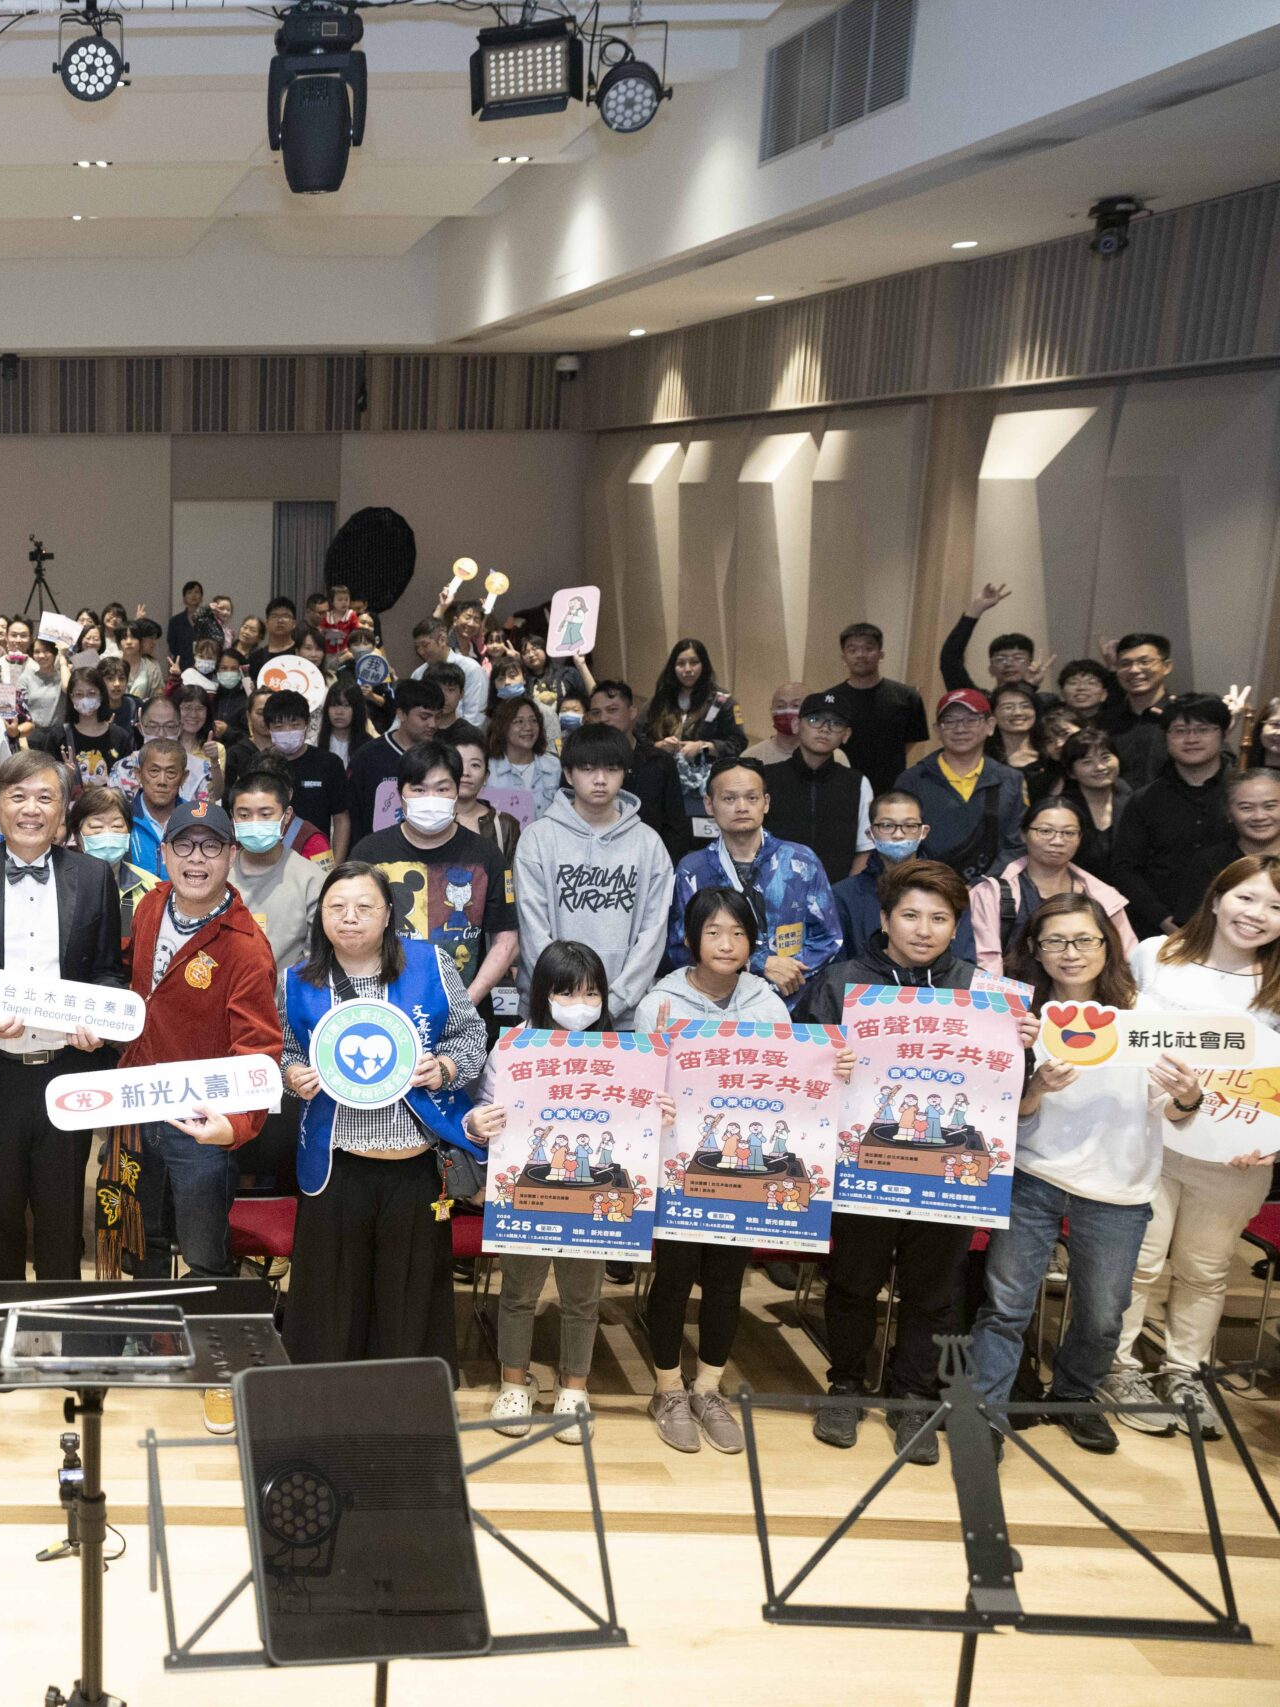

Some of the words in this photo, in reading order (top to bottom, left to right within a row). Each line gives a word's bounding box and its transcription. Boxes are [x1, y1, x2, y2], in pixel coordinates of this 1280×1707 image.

[4, 984, 137, 1017] 台北木笛合奏團
[1, 1001, 31, 1015] Taipei
[34, 1007, 81, 1023] Recorder
[84, 1015, 135, 1032] Orchestra
[412, 1004, 432, 1052] 文豪社
[854, 1015, 969, 1039] 笛聲傳愛
[1128, 1030, 1246, 1050] 新北社會局
[508, 1057, 615, 1082] 笛聲傳愛
[675, 1047, 789, 1071] 笛聲傳愛
[897, 1043, 1015, 1073] 親子共響
[718, 1073, 832, 1100] 親子共響
[889, 1067, 965, 1085] 音樂柑仔店
[76, 1092, 92, 1108] 光
[120, 1074, 231, 1109] 新光人壽
[548, 1083, 655, 1109] 親子共響
[542, 1109, 609, 1123] 音樂柑仔店
[711, 1097, 784, 1112] 音樂柑仔店
[839, 1178, 877, 1191] 4.25
[666, 1206, 703, 1218] 4.25
[496, 1219, 532, 1231] 4.25
